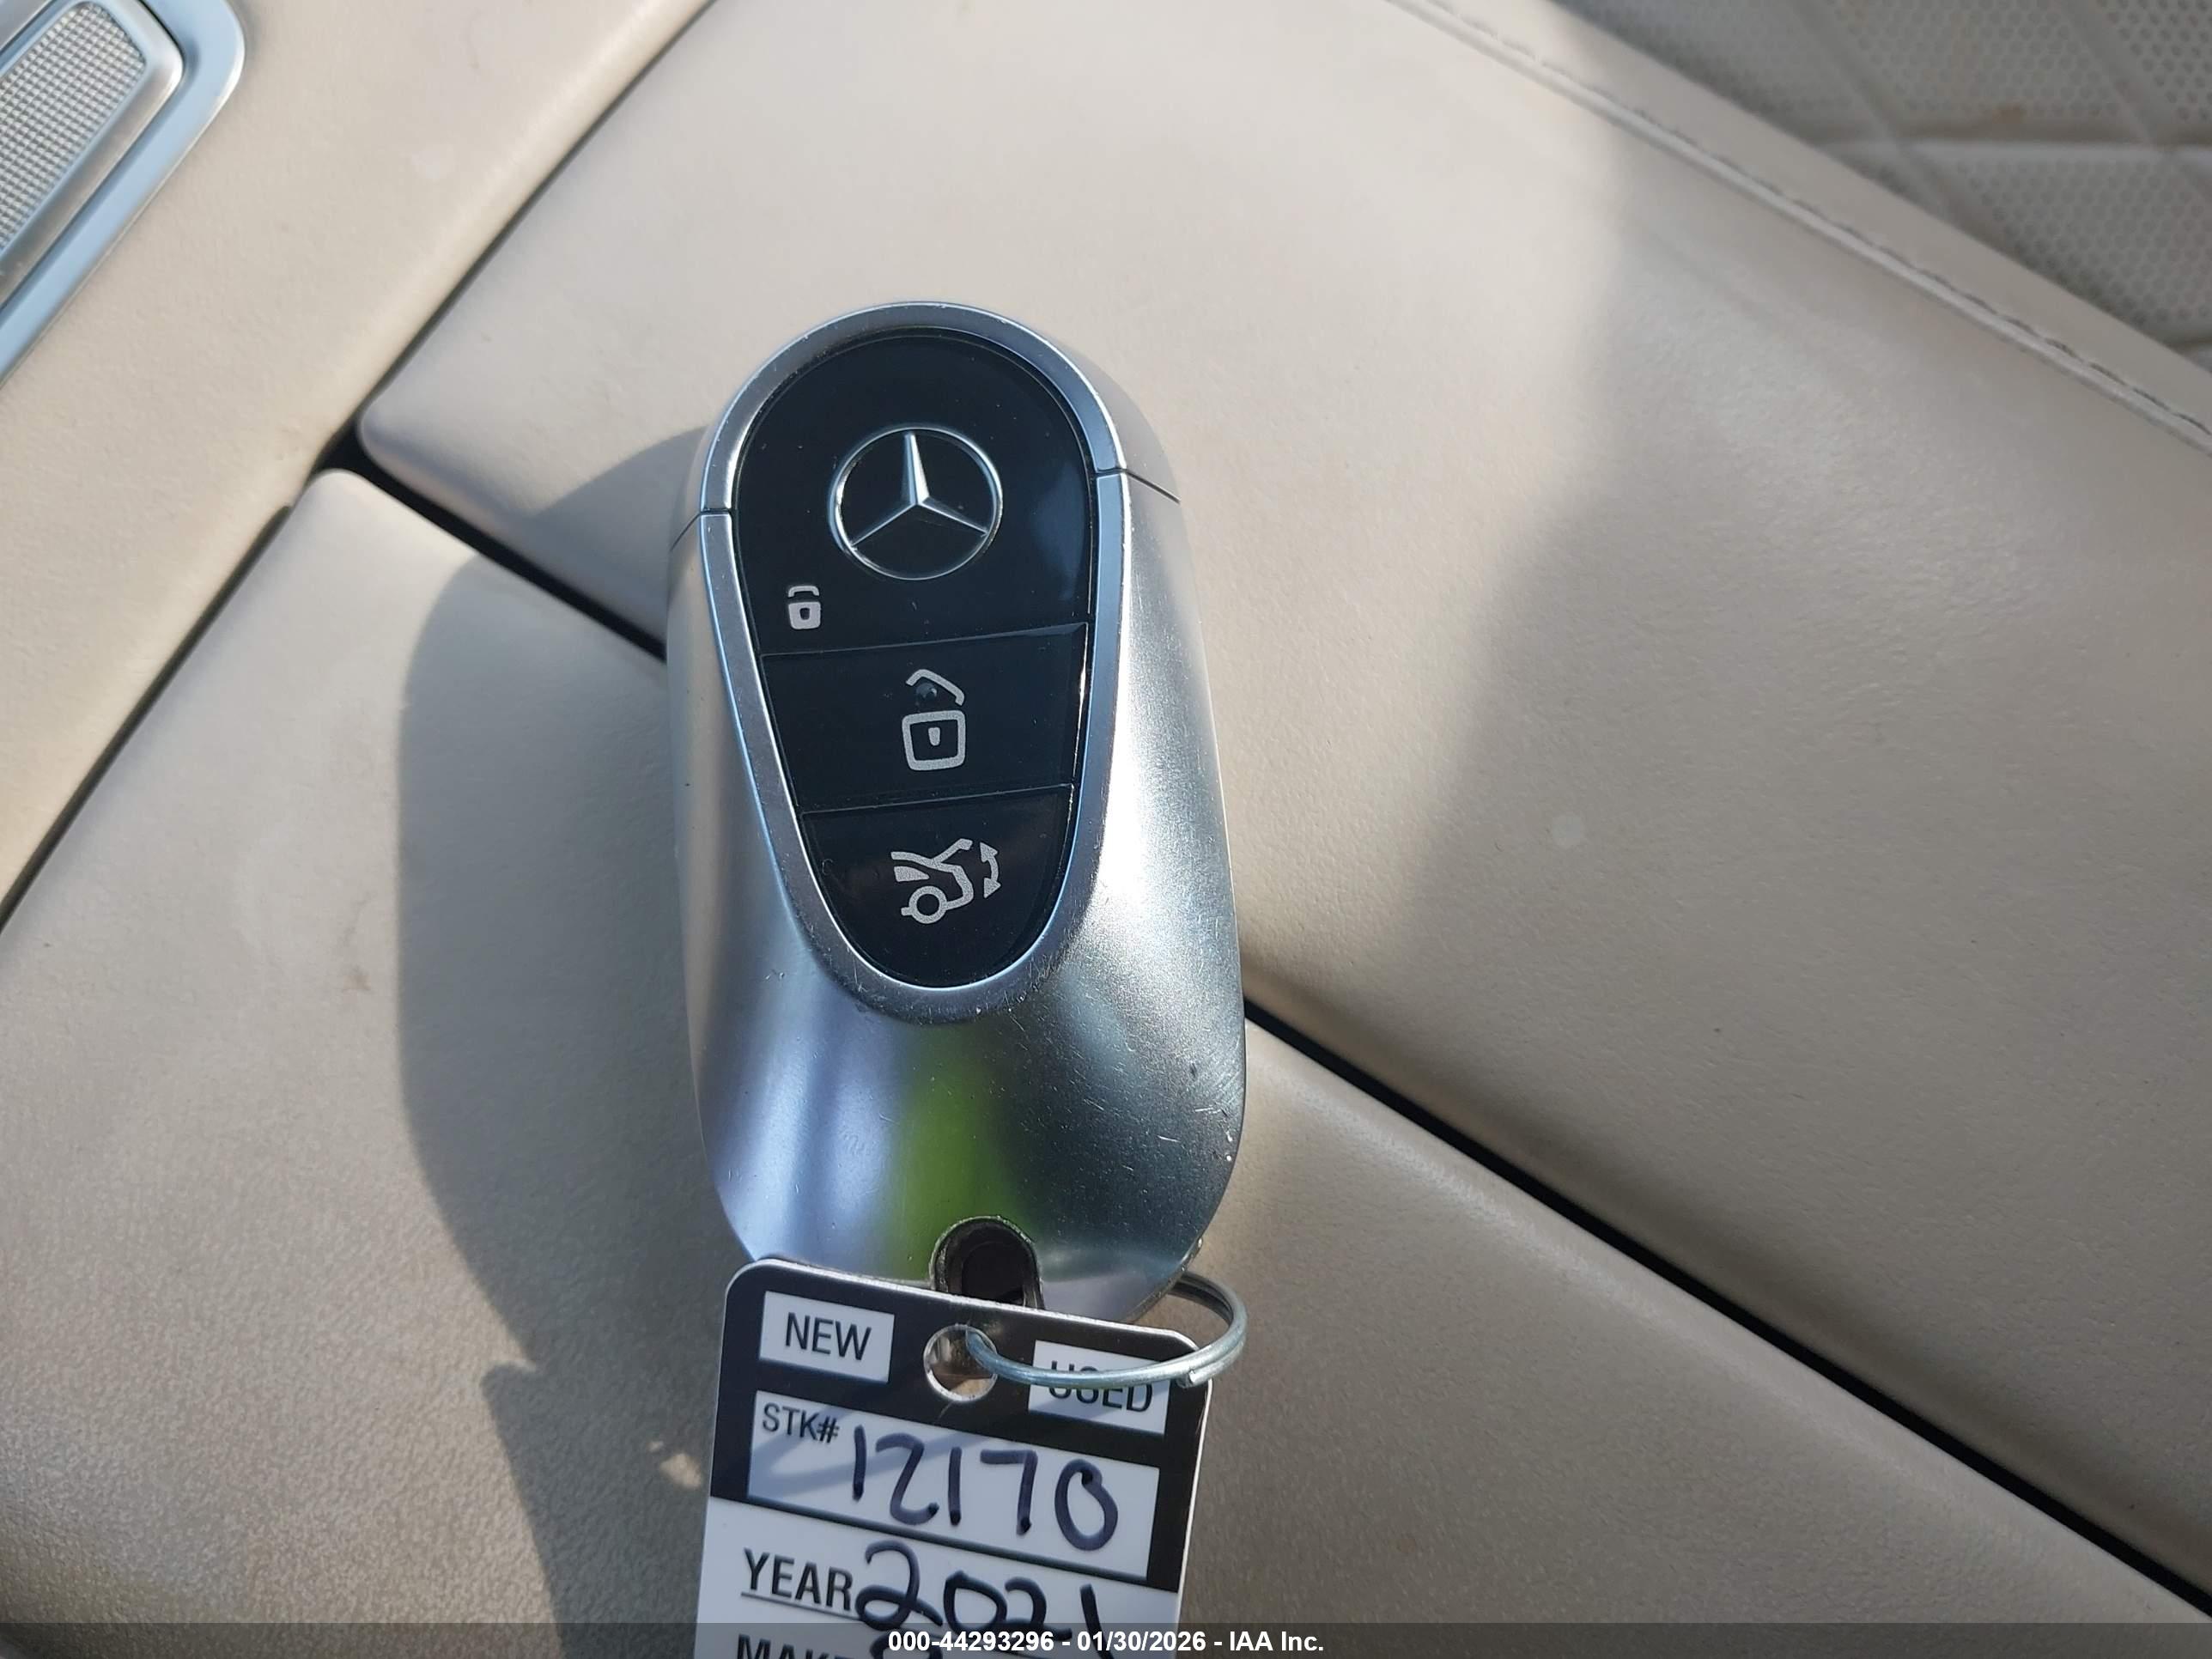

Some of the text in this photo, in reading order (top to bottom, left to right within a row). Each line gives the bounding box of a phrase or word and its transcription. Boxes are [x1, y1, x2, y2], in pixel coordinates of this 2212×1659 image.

[785, 1312, 872, 1361] NEW
[762, 1402, 840, 1443] STK#
[852, 1425, 1119, 1551] 12170
[744, 1548, 854, 1612] YEAR
